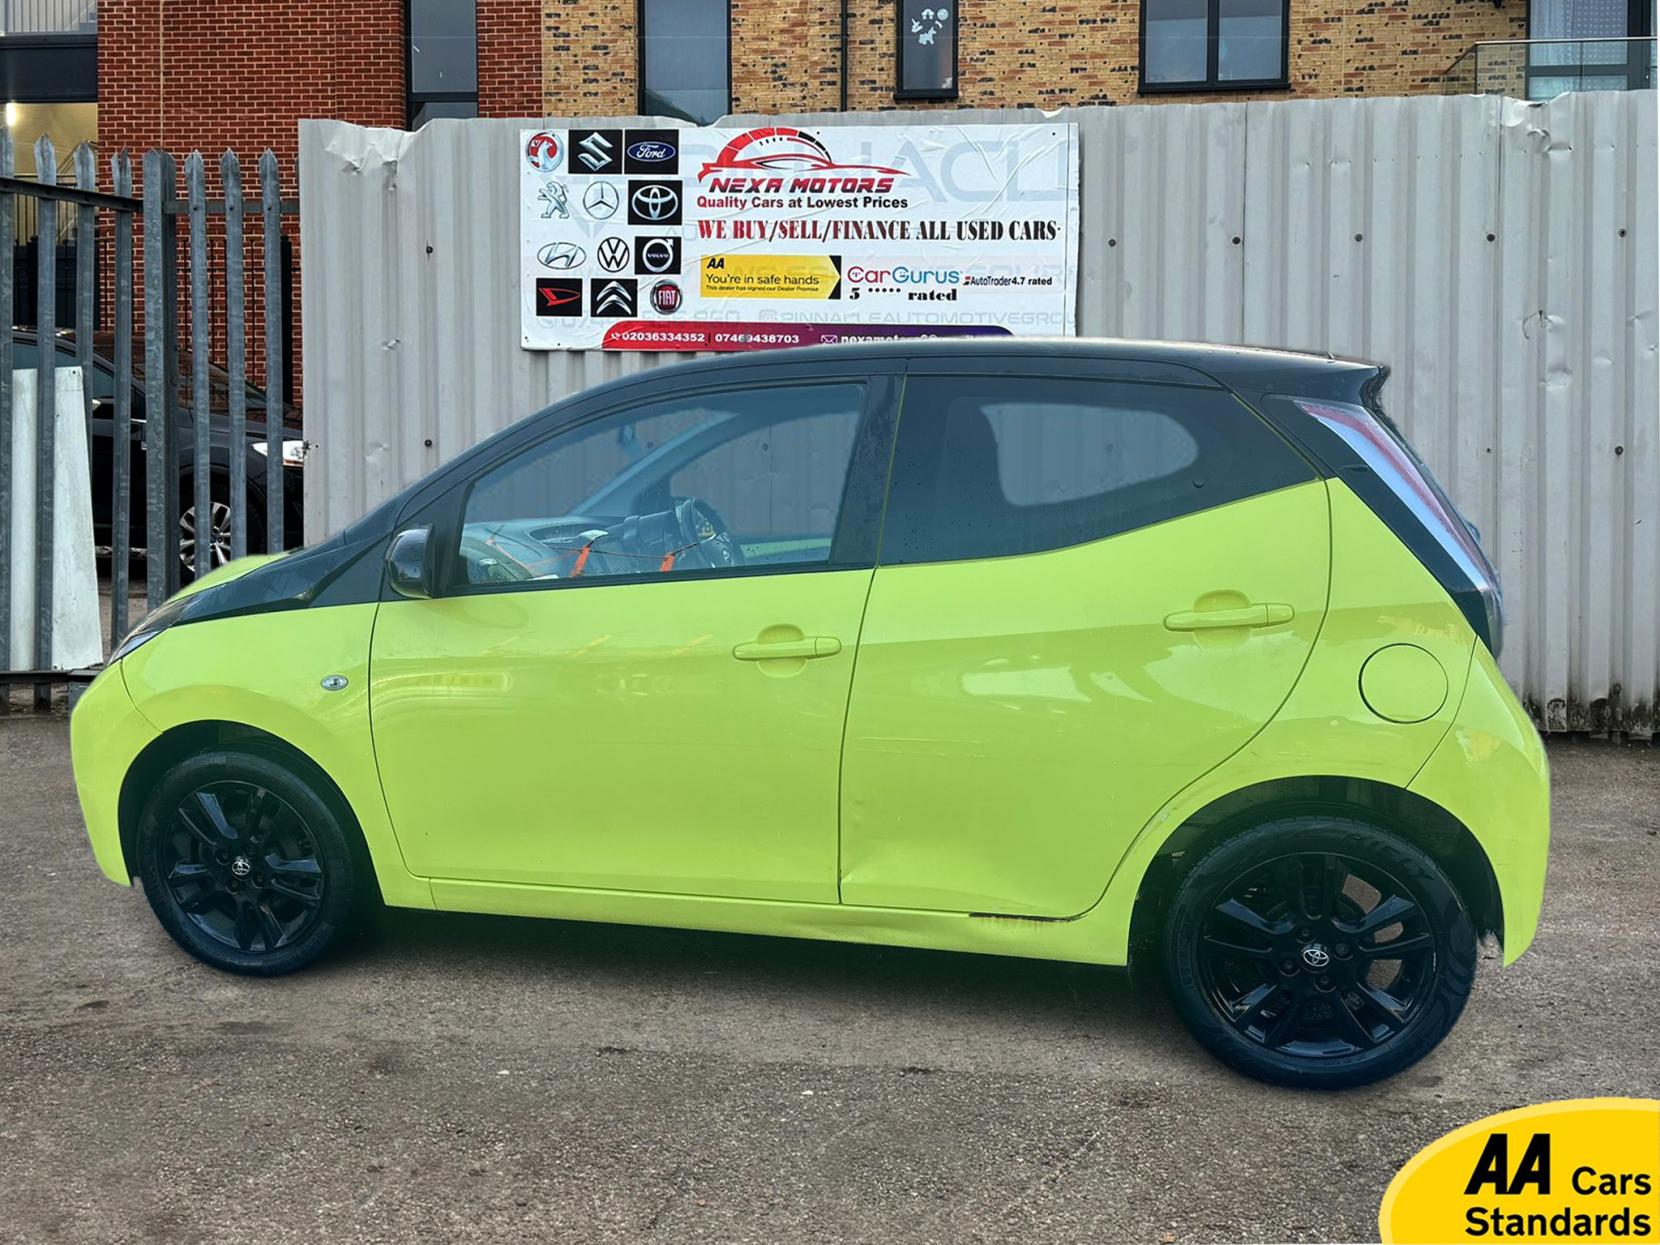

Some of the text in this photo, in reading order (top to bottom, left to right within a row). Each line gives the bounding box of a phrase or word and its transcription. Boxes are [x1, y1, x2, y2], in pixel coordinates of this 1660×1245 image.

[636, 144, 666, 159] Ford
[708, 177, 895, 194] NEXA MOTORS
[697, 196, 908, 211] Quality Cars at Lowest Prices
[697, 220, 727, 240] WE
[916, 220, 951, 240] ALL
[956, 220, 1004, 241] USED
[706, 257, 725, 269] AA
[706, 273, 820, 285] You're in safe hands
[847, 265, 960, 284] CarGurus
[1028, 276, 1052, 285] rated
[658, 290, 676, 306] FIAT
[849, 287, 957, 301] 5 rated
[622, 332, 705, 342] 02036334352
